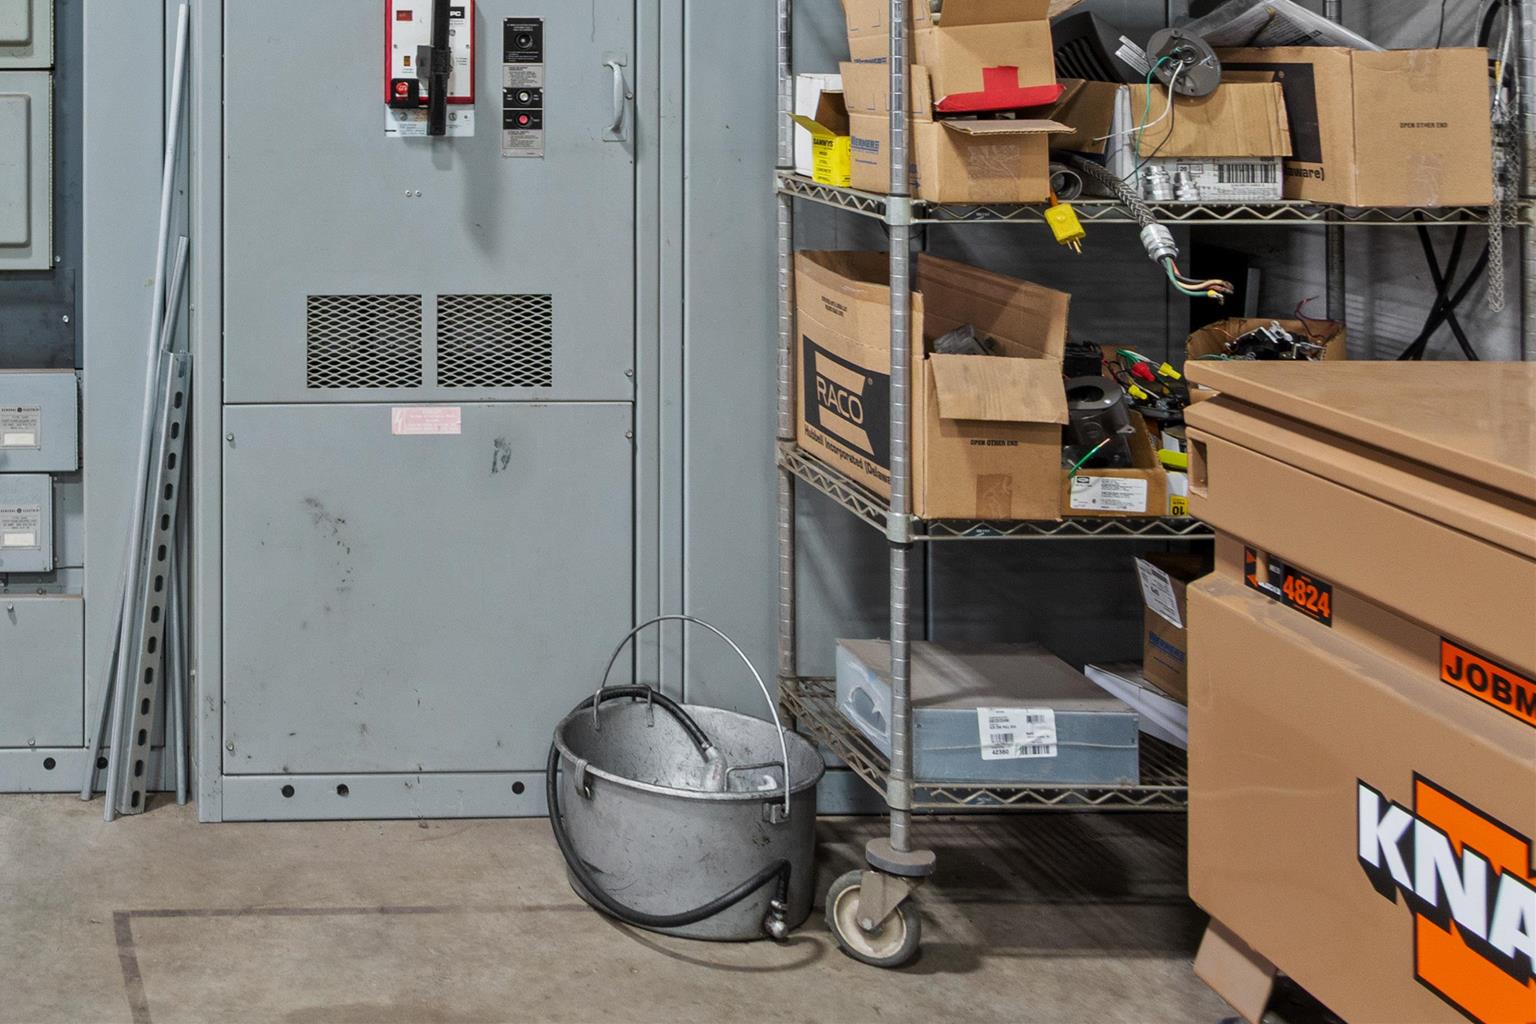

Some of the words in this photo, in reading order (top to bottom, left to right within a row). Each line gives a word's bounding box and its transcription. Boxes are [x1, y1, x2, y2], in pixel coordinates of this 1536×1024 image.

[816, 375, 864, 425] RACO
[805, 423, 824, 447] Hubbell
[824, 436, 864, 470] Incorporated
[1282, 575, 1330, 619] 4824
[1446, 654, 1536, 717] JOBM
[1357, 780, 1536, 975] KNA
